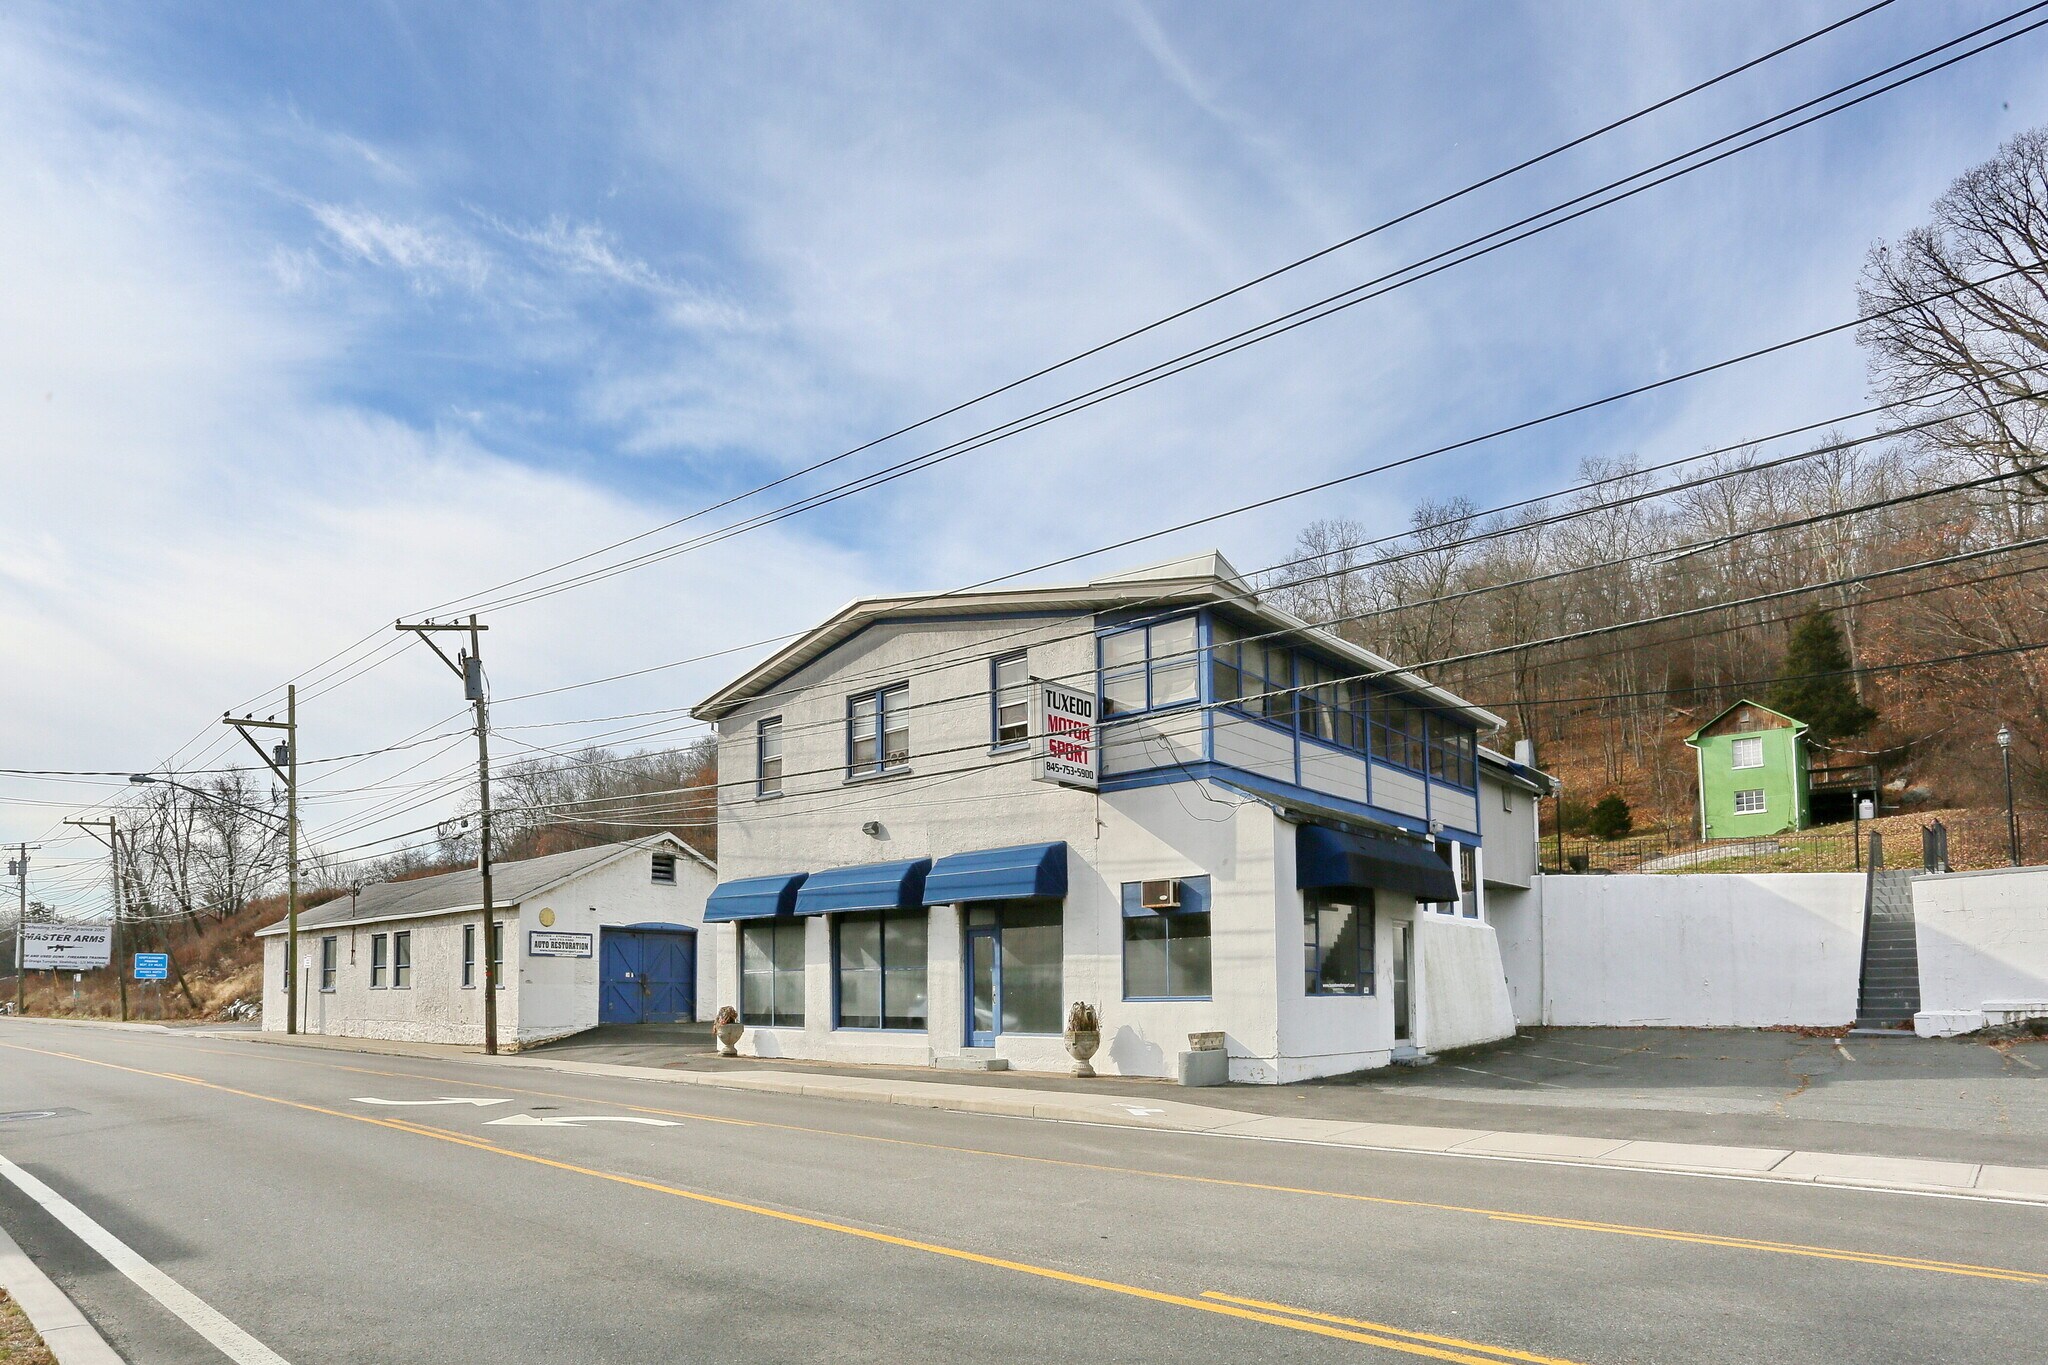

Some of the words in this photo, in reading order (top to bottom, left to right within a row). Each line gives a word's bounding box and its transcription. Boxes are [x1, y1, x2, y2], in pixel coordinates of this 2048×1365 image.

[1045, 690, 1091, 718] TUXEDO
[1047, 713, 1091, 742] MOTOR
[1048, 738, 1089, 765] SPORT
[1045, 761, 1094, 780] 845-753-5900
[25, 932, 70, 942] MASTER
[73, 934, 106, 943] ARMS
[534, 941, 550, 949] AUTO
[550, 941, 589, 950] RESTORATION
